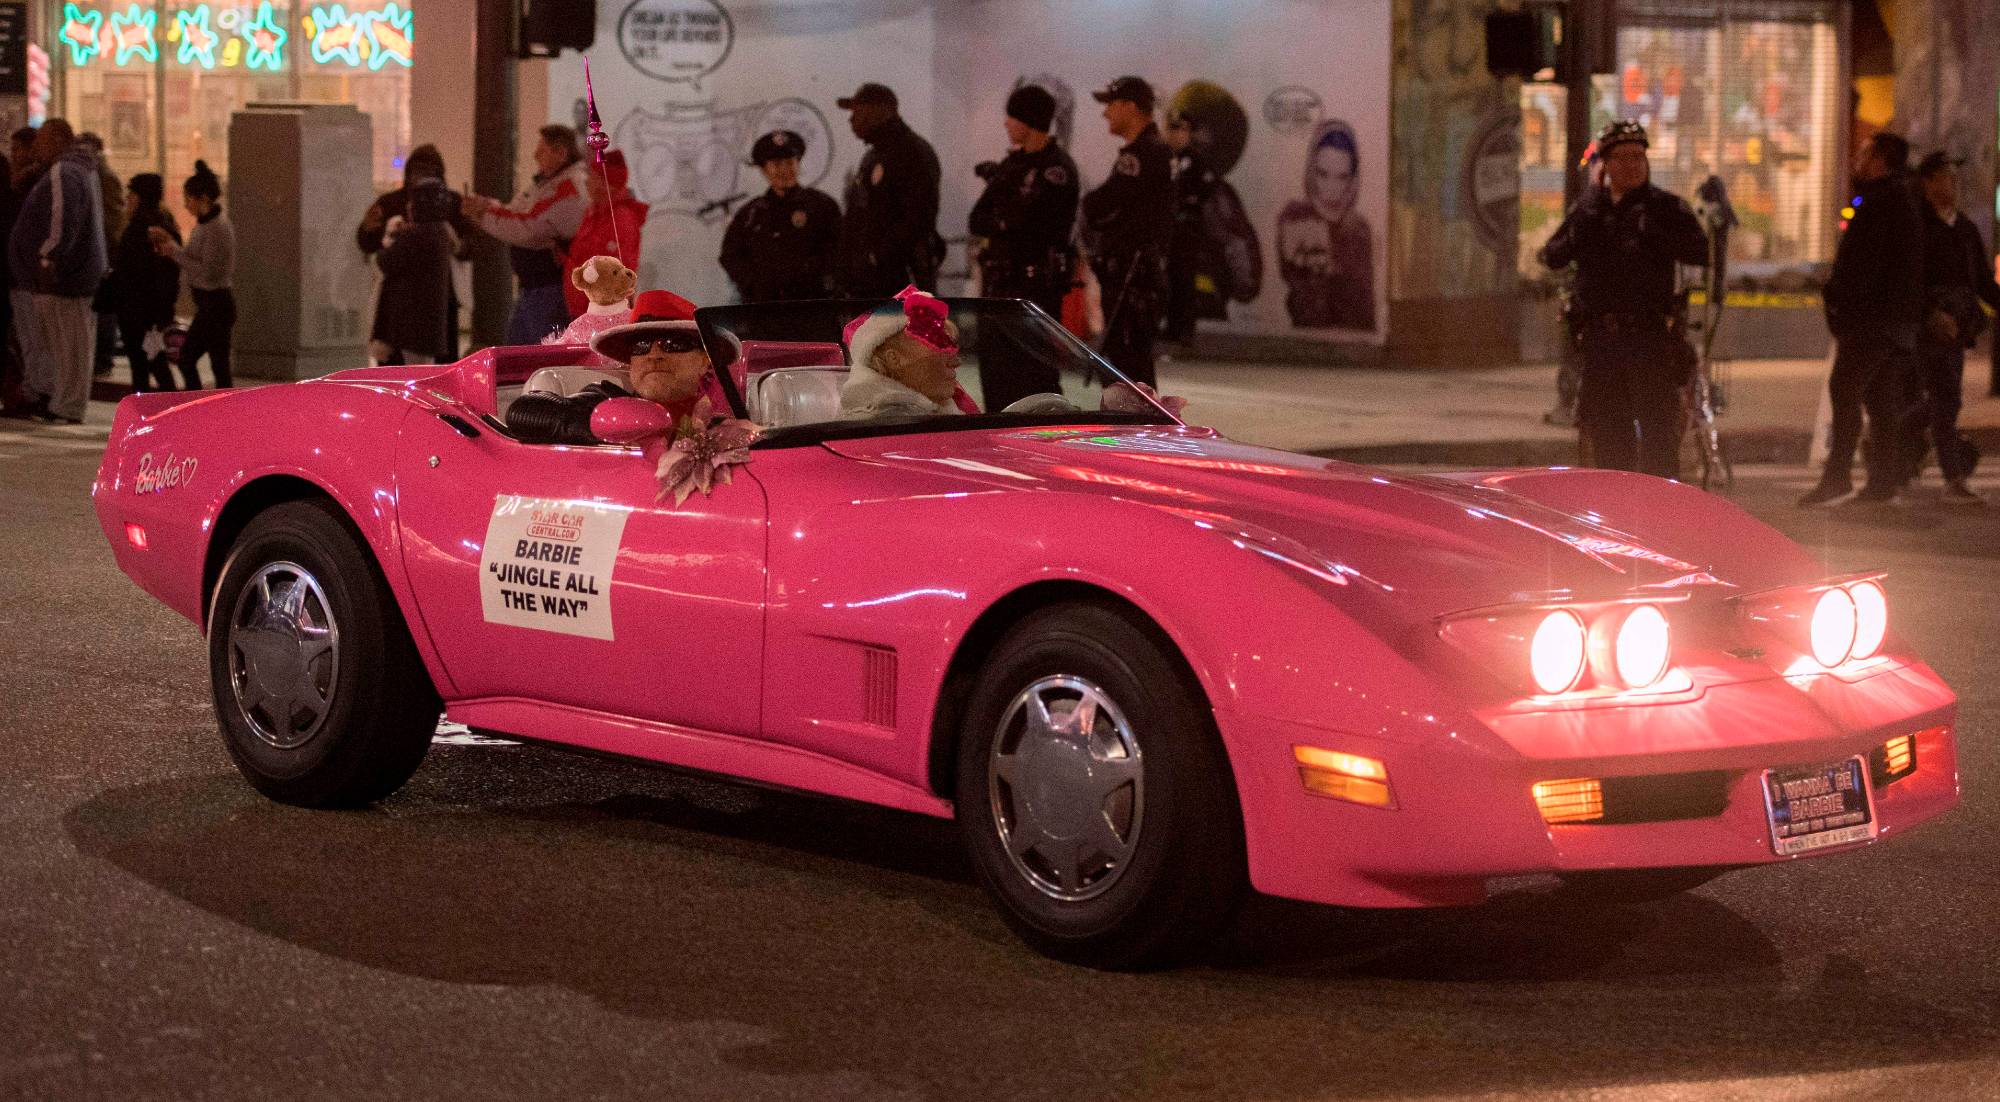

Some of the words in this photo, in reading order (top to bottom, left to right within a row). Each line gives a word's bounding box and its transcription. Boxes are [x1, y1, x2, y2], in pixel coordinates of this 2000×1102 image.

[136, 453, 179, 494] Barbie
[561, 513, 585, 527] CAR
[531, 526, 577, 540] CENTRAL.COM
[515, 539, 583, 565] BARBIE
[565, 573, 599, 595] ALL
[501, 590, 538, 612] THE
[1783, 776, 1833, 800] WANNA
[1835, 771, 1852, 791] BE
[1790, 793, 1844, 820] BARBIE
